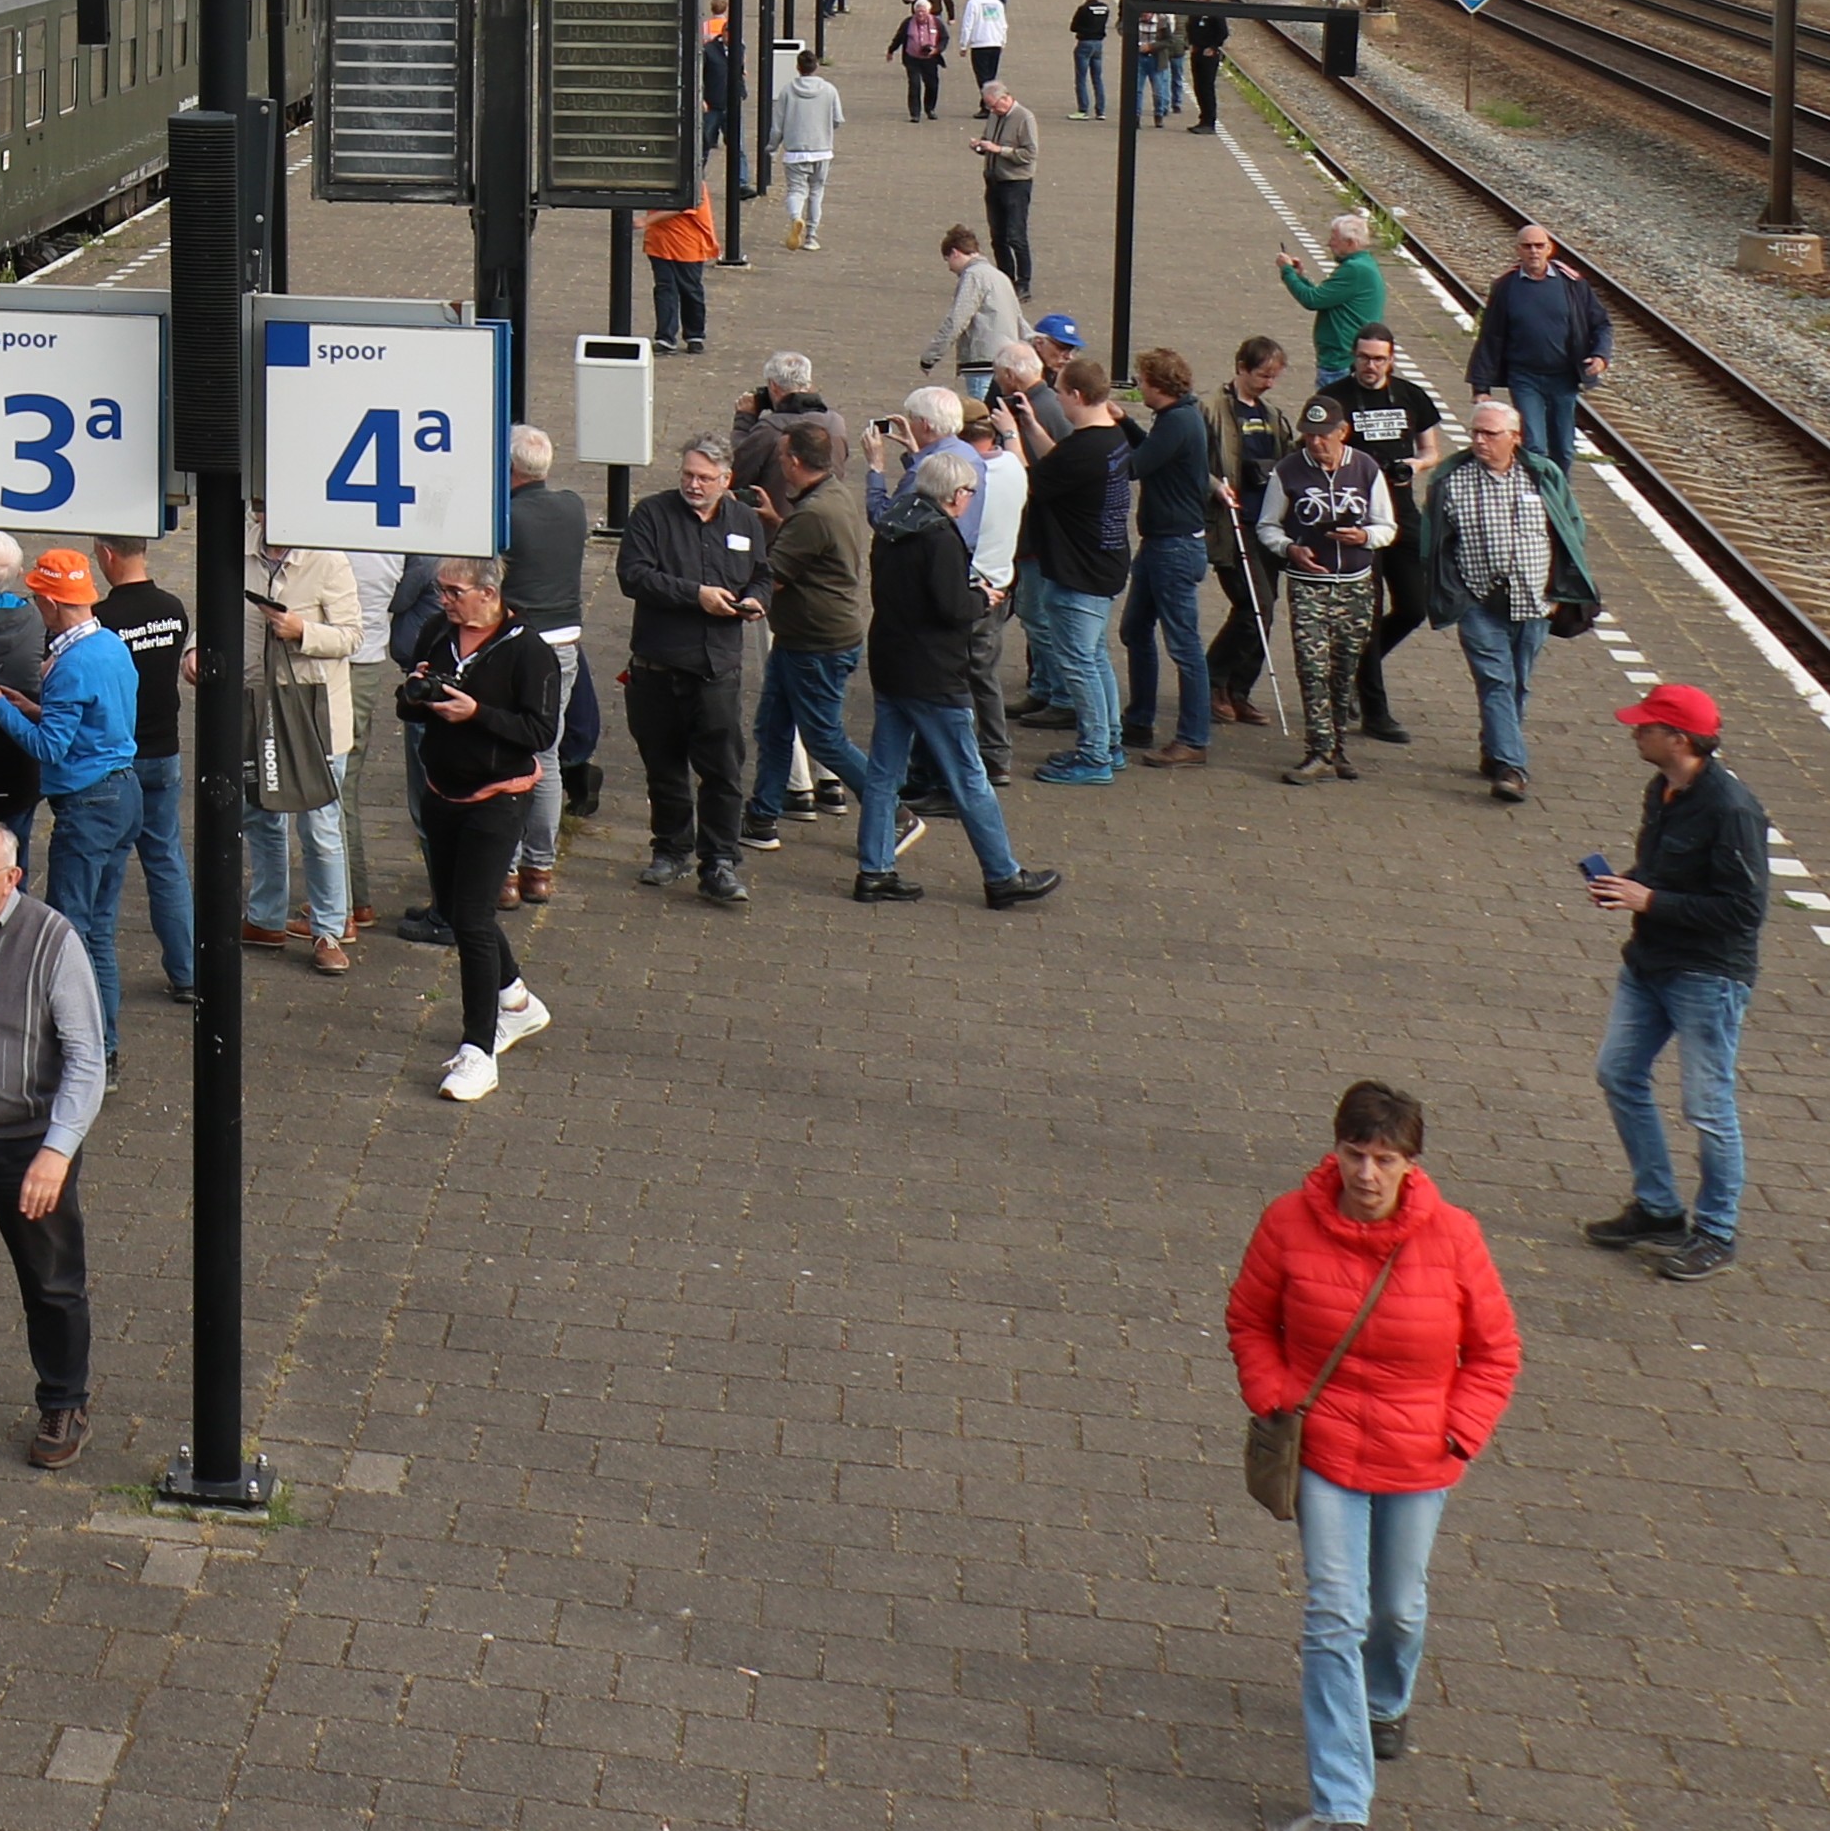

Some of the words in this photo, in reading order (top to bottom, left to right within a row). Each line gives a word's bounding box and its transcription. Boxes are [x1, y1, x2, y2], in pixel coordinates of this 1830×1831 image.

[589, 72, 644, 86] BREDA
[316, 340, 387, 363] spoor
[146, 617, 182, 633] Stichting
[132, 632, 174, 651] Nederland
[265, 738, 279, 791] KROON
